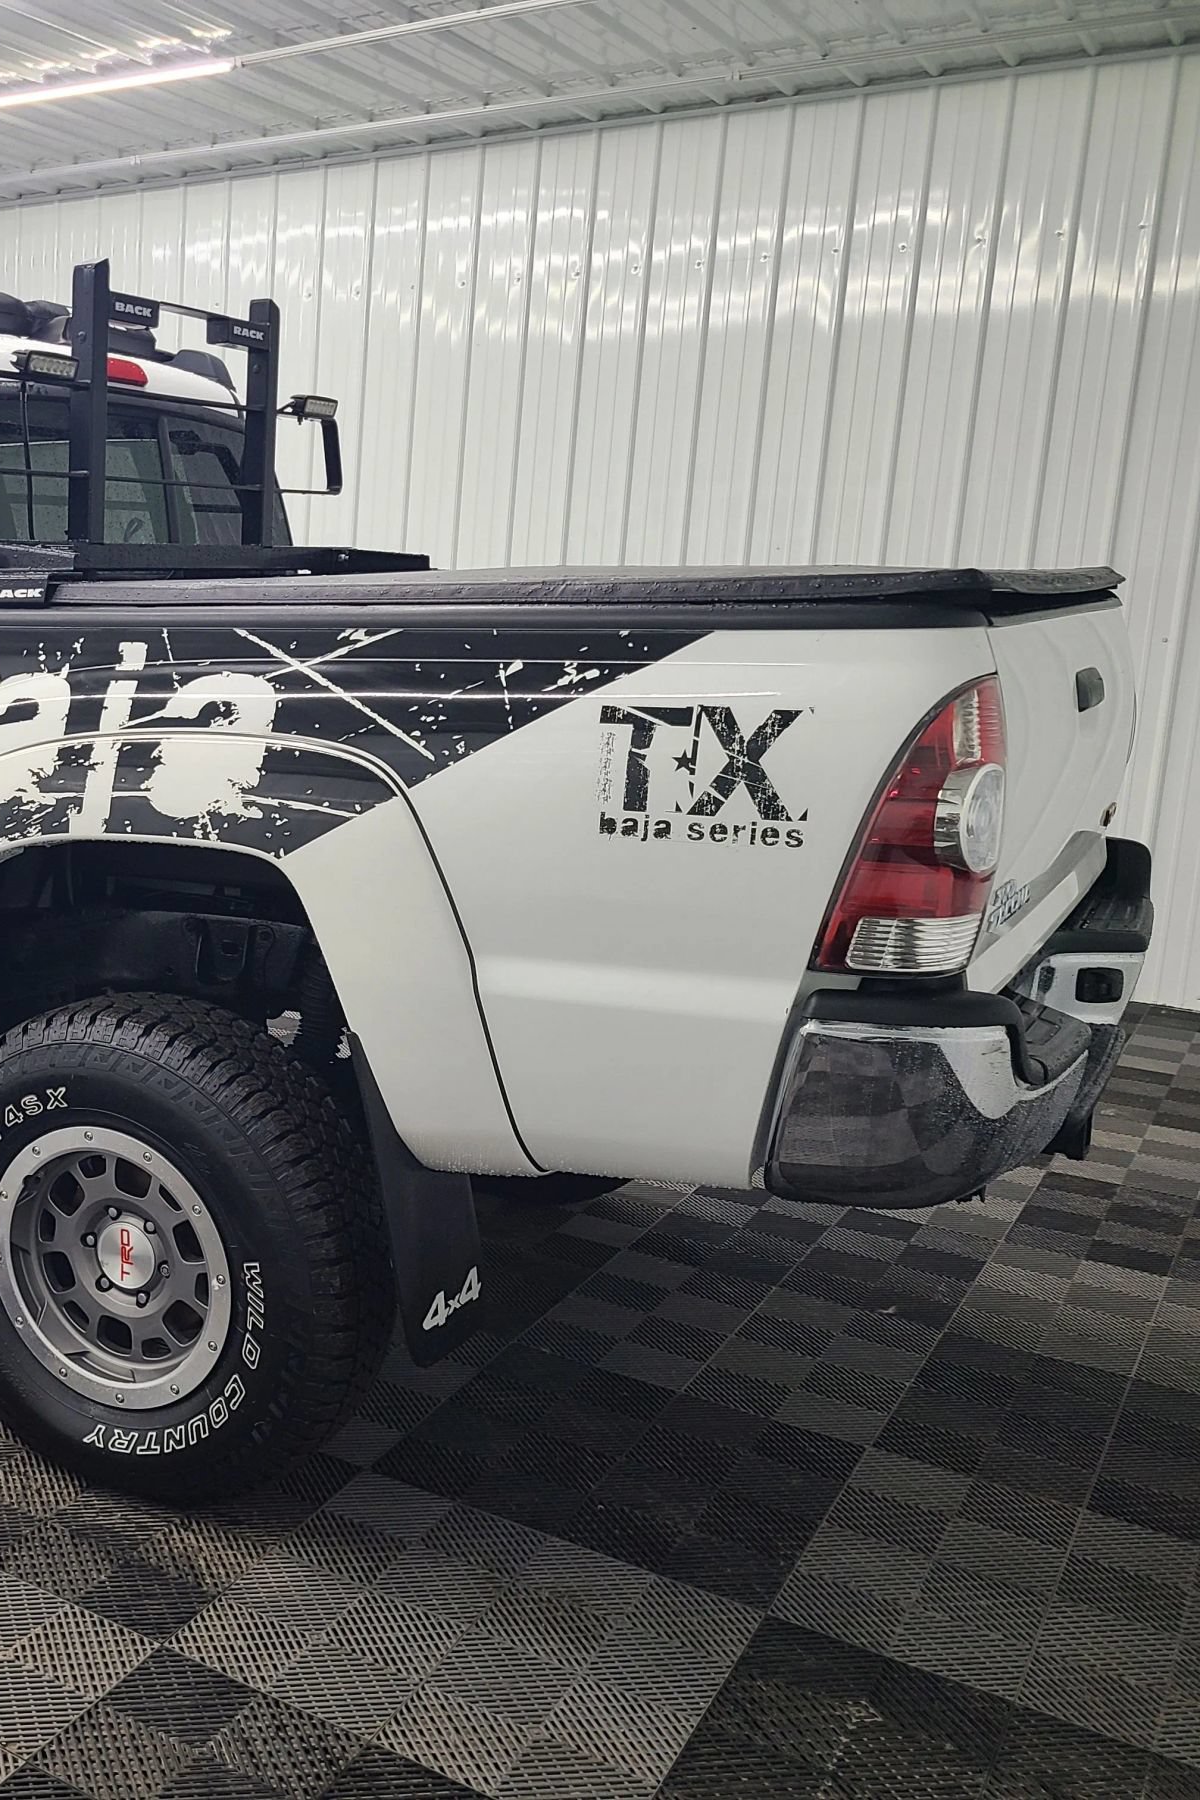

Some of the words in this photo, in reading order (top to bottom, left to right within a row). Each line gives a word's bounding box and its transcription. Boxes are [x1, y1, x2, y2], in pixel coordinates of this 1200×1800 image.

[114, 301, 153, 318] BACK
[232, 325, 265, 341] RACK
[599, 811, 672, 842] baja
[686, 821, 805, 848] series
[3, 1086, 68, 1128] 4SX
[120, 1228, 134, 1282] TRD
[241, 1260, 263, 1370] WILD
[422, 1264, 481, 1332] 4x4
[83, 1371, 247, 1455] COUNTRY
